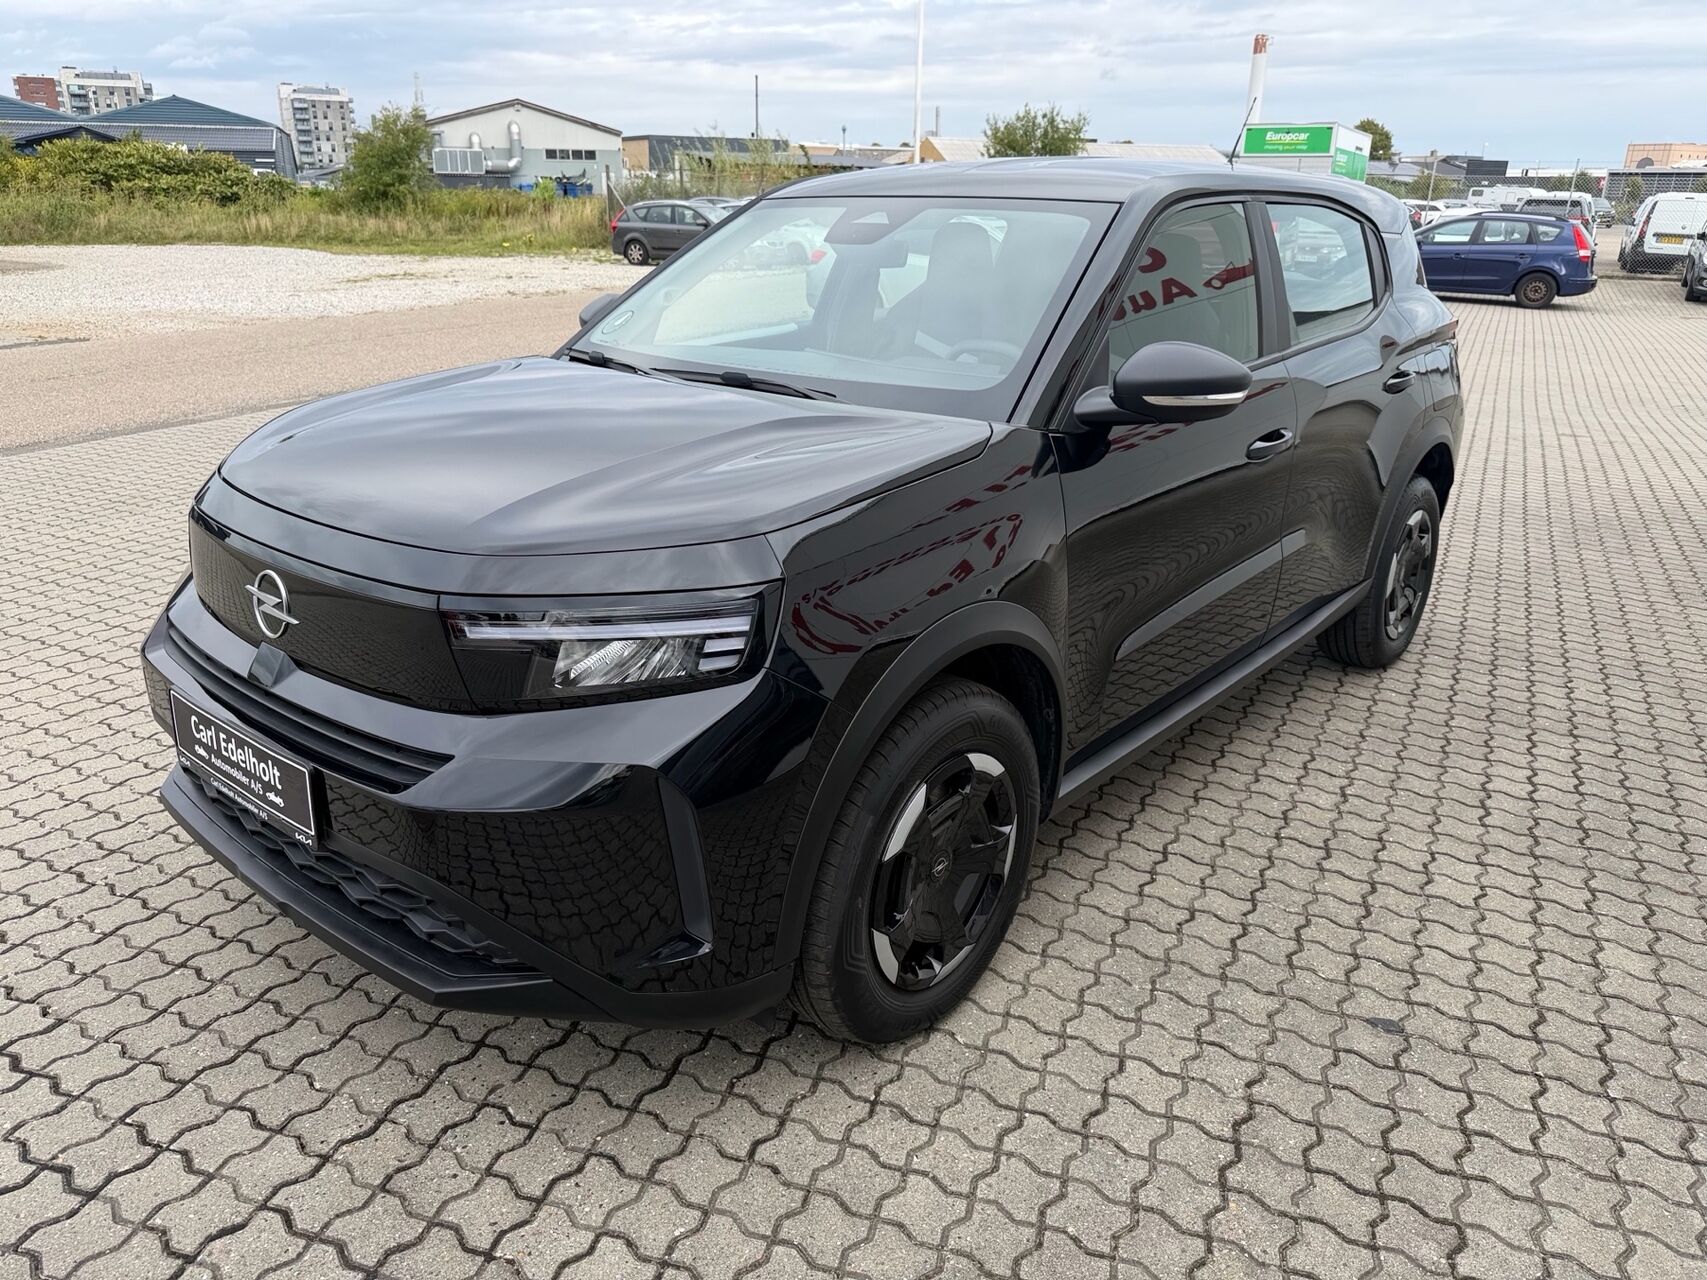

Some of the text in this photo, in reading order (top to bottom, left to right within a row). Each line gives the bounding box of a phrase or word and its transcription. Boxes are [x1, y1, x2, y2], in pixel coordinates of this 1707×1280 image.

[1265, 131, 1310, 142] Europcar
[190, 714, 282, 790] Carl Edelholt
[211, 753, 264, 795] Automobiler A/S
